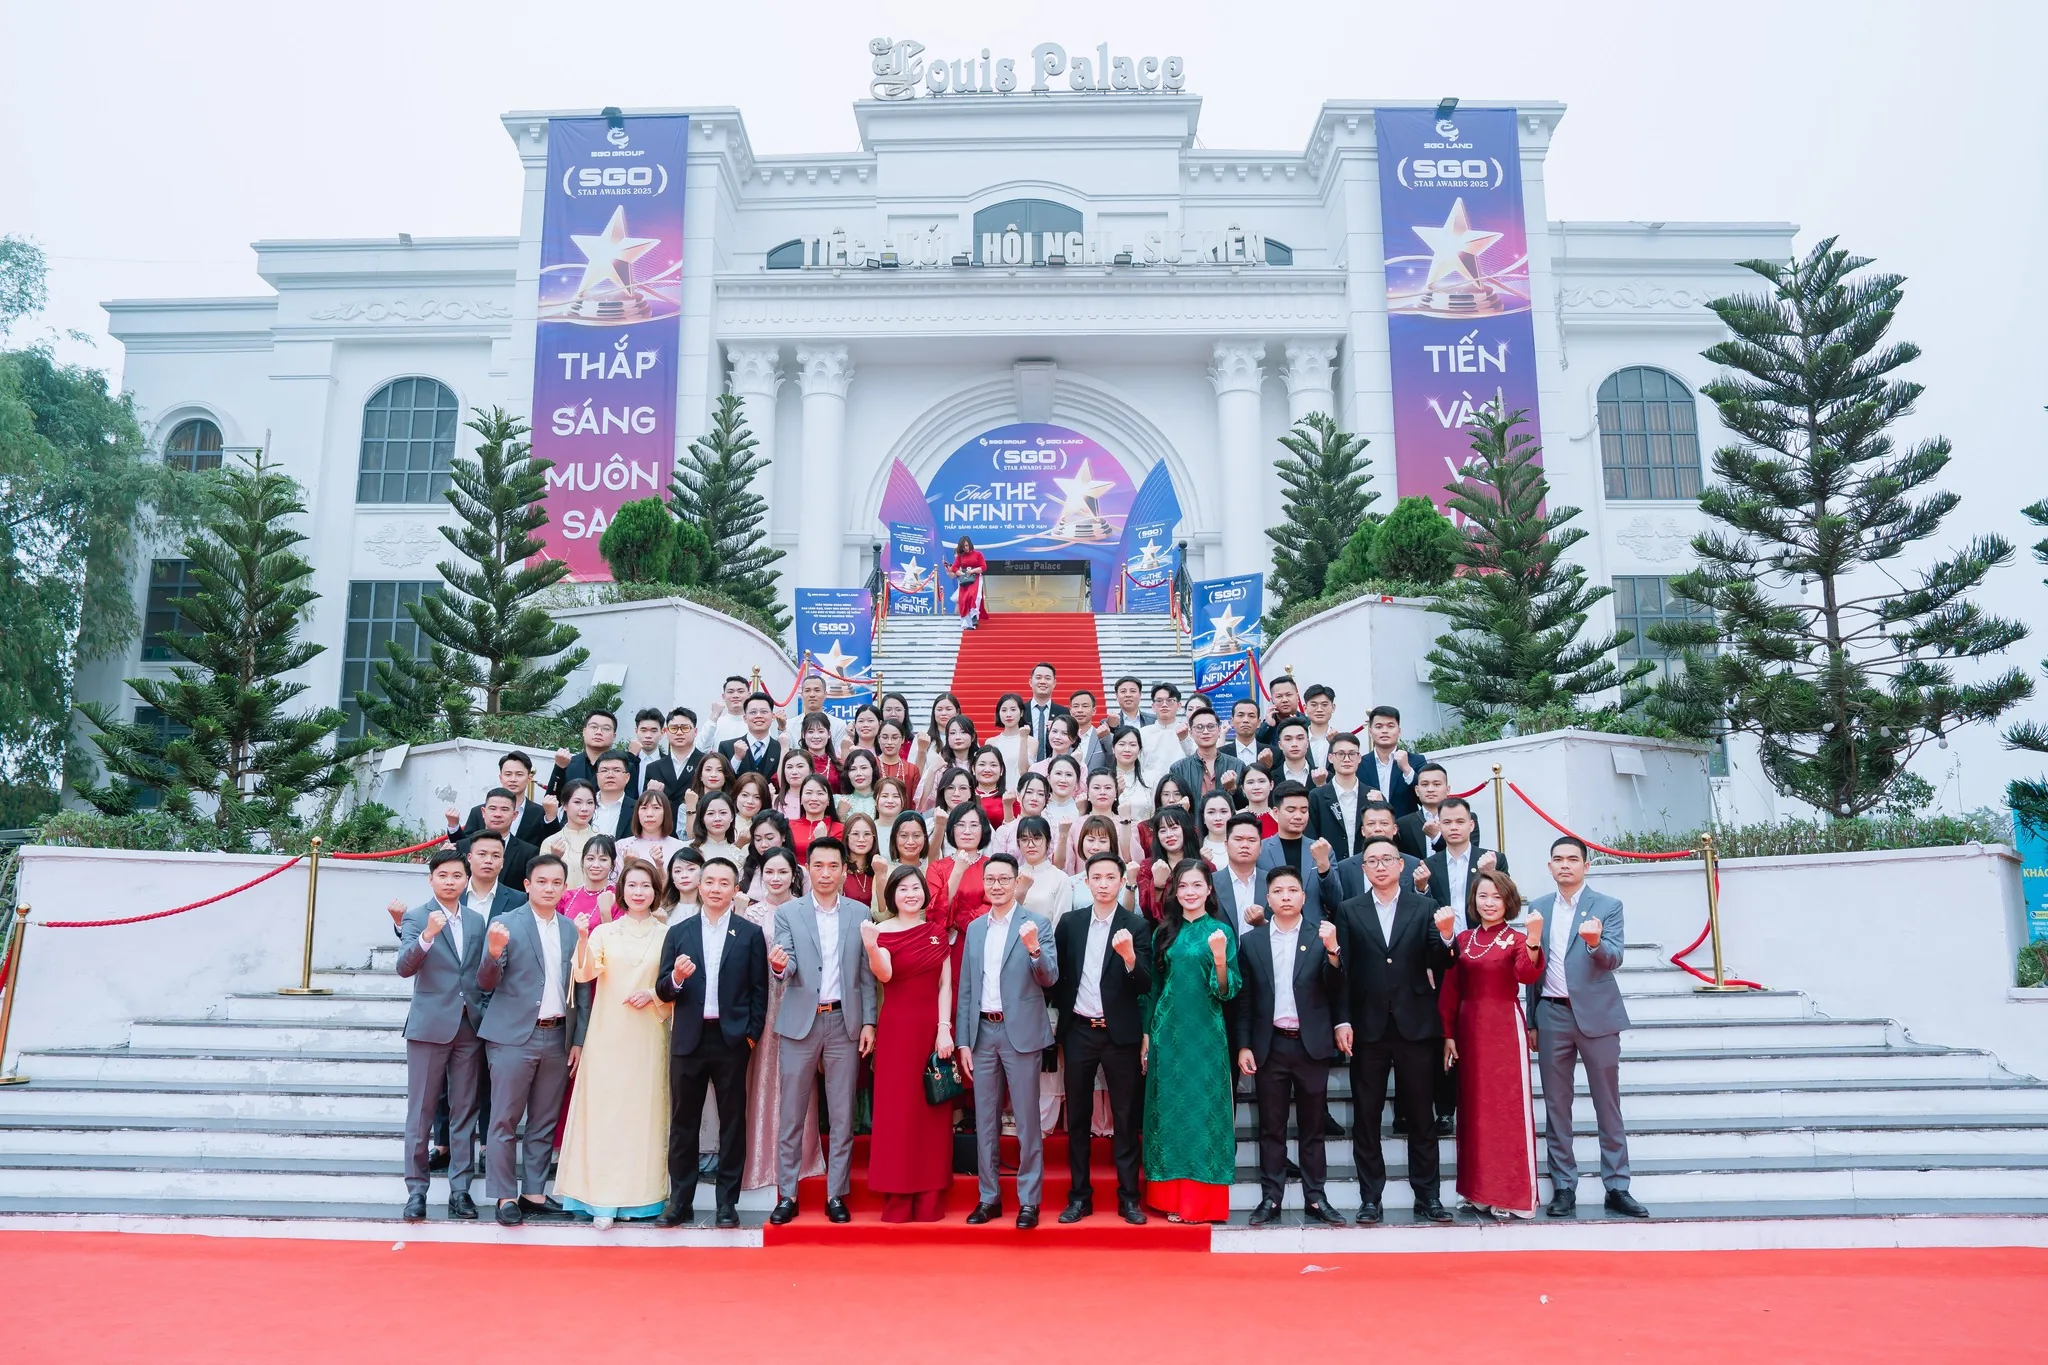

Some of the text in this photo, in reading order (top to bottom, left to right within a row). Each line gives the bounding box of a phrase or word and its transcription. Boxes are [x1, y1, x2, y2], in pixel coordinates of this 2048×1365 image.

[1031, 41, 1186, 91] Palace
[578, 166, 653, 187] SGO
[1412, 160, 1488, 178] SGO
[600, 188, 632, 196] AWARDS
[633, 187, 652, 195] 2025
[1413, 180, 1489, 188] STAR AWARDS 2025
[557, 333, 656, 380] THẮP
[1423, 329, 1507, 373] TIẾN
[551, 397, 656, 436] SÁNG
[1003, 449, 1056, 464] SGO
[543, 452, 659, 492] MUÔN
[990, 482, 1037, 500] THE
[944, 503, 1047, 522] INFINITY
[562, 507, 617, 540] SA
[1033, 561, 1061, 570] Palace
[1148, 571, 1162, 580] THE
[910, 595, 928, 606] THE
[1214, 588, 1241, 600] SGO
[894, 602, 932, 614] INFINITY
[818, 622, 849, 632] SGO
